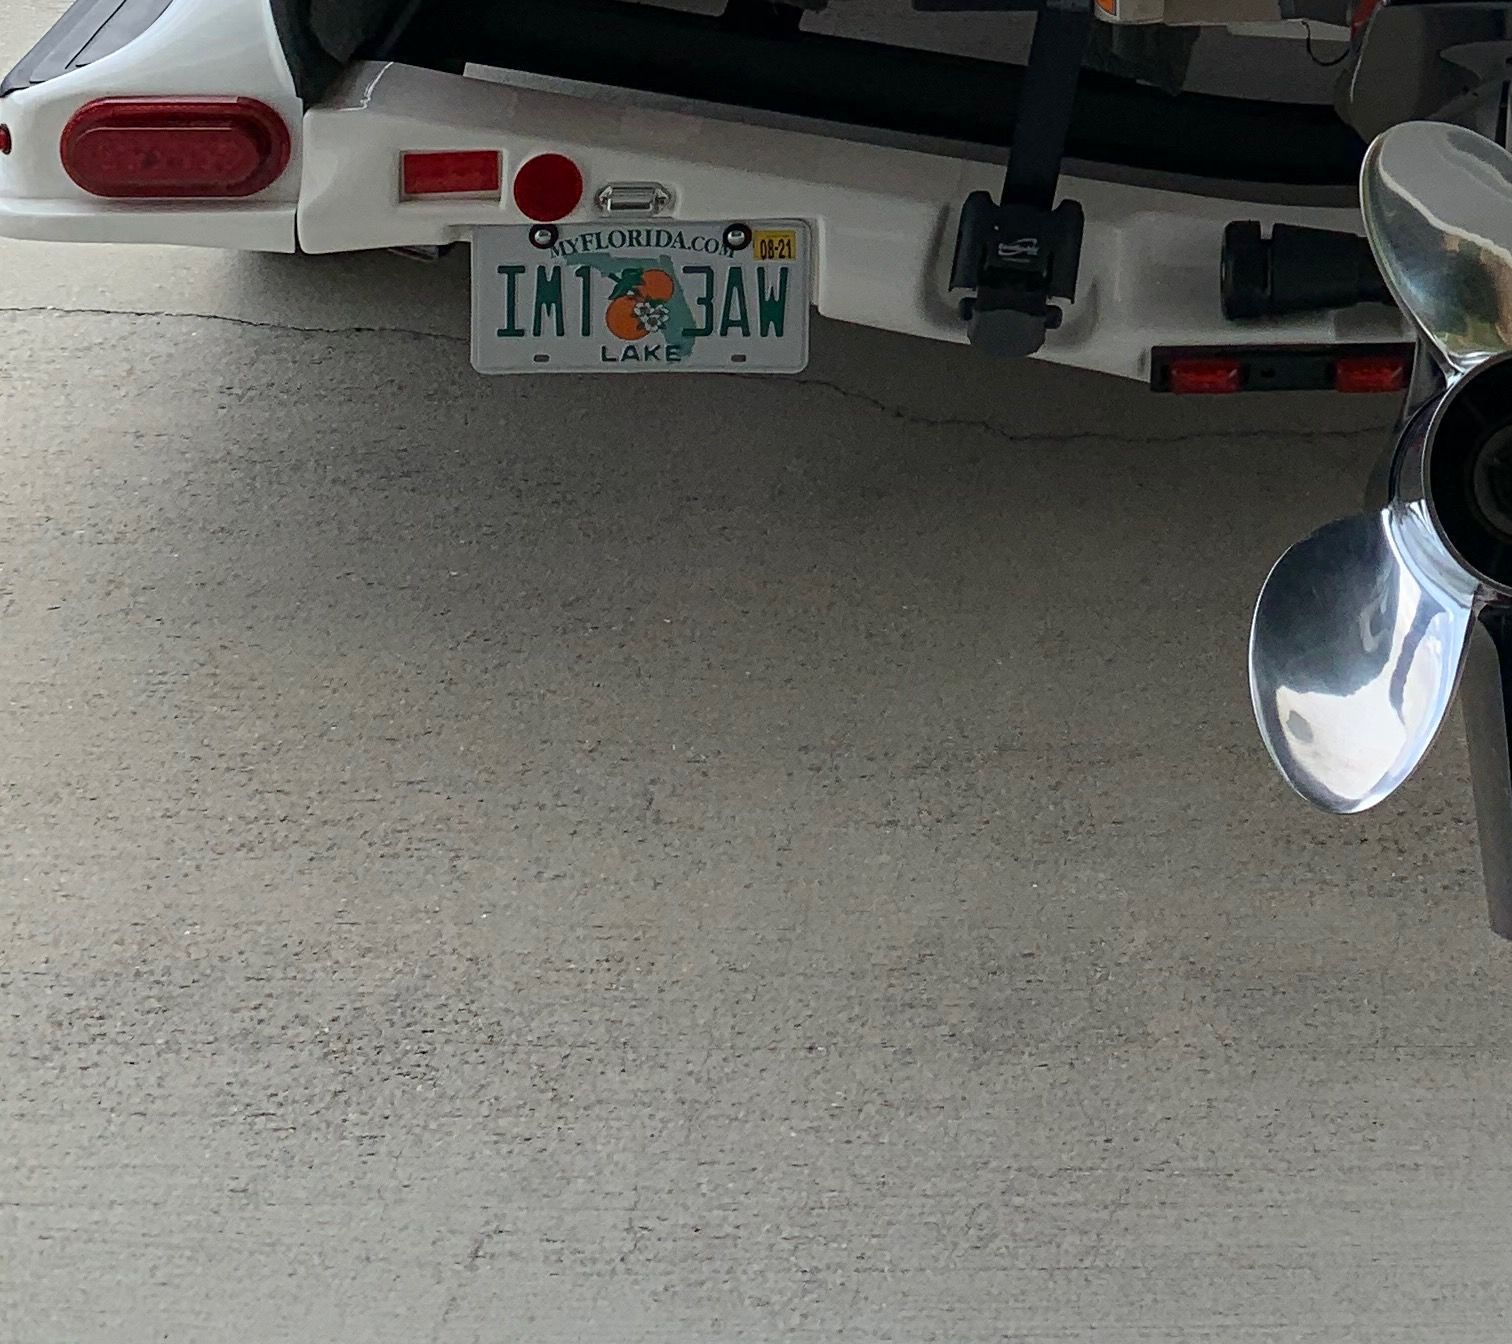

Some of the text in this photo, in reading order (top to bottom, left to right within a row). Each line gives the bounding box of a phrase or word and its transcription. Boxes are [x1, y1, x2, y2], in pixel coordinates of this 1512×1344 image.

[550, 229, 735, 259] MYFLORIDA.COM
[760, 238, 792, 260] 08-21
[682, 265, 788, 337] 3AW
[601, 344, 683, 362] LAKE
